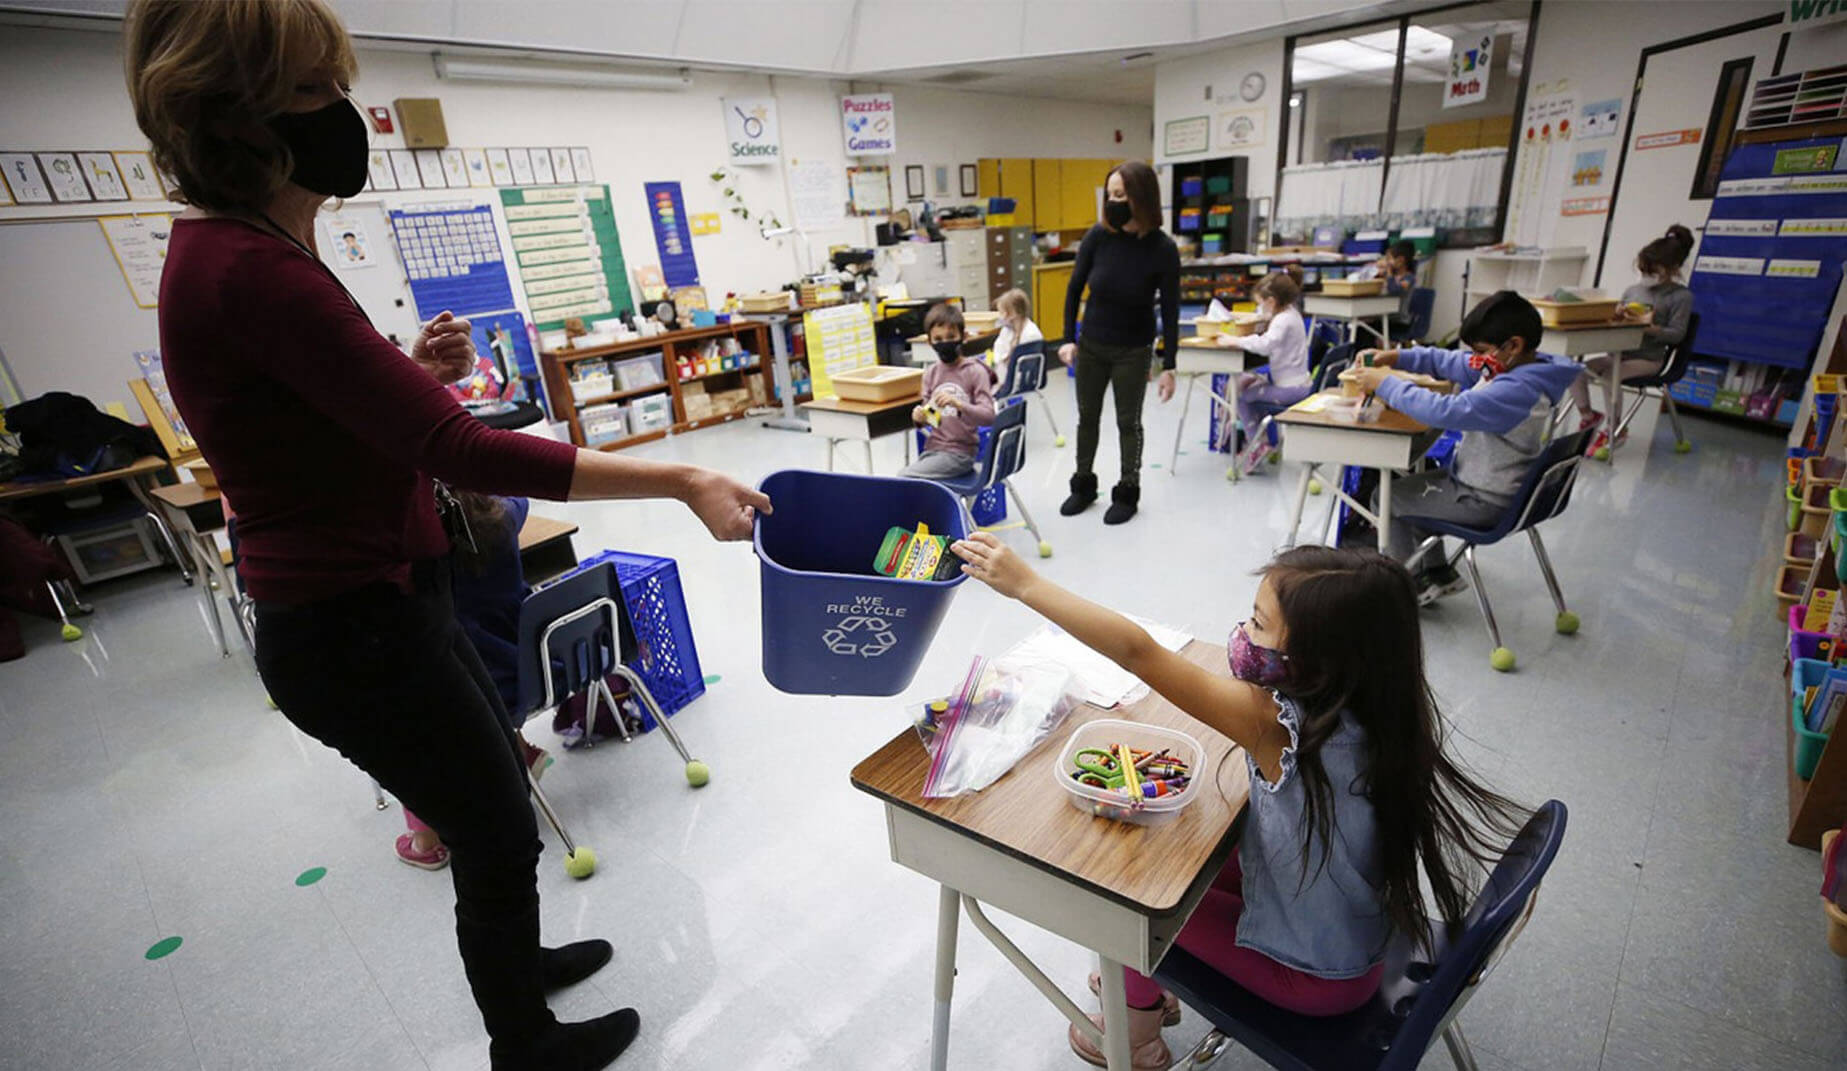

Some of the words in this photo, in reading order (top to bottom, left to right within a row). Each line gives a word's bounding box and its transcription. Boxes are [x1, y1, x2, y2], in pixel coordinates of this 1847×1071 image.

[1451, 78, 1480, 97] Math
[843, 99, 892, 113] Puzzles
[732, 143, 778, 156] Science
[848, 137, 891, 150] Games
[855, 596, 884, 606] WE
[826, 604, 907, 618] RECYCLE
